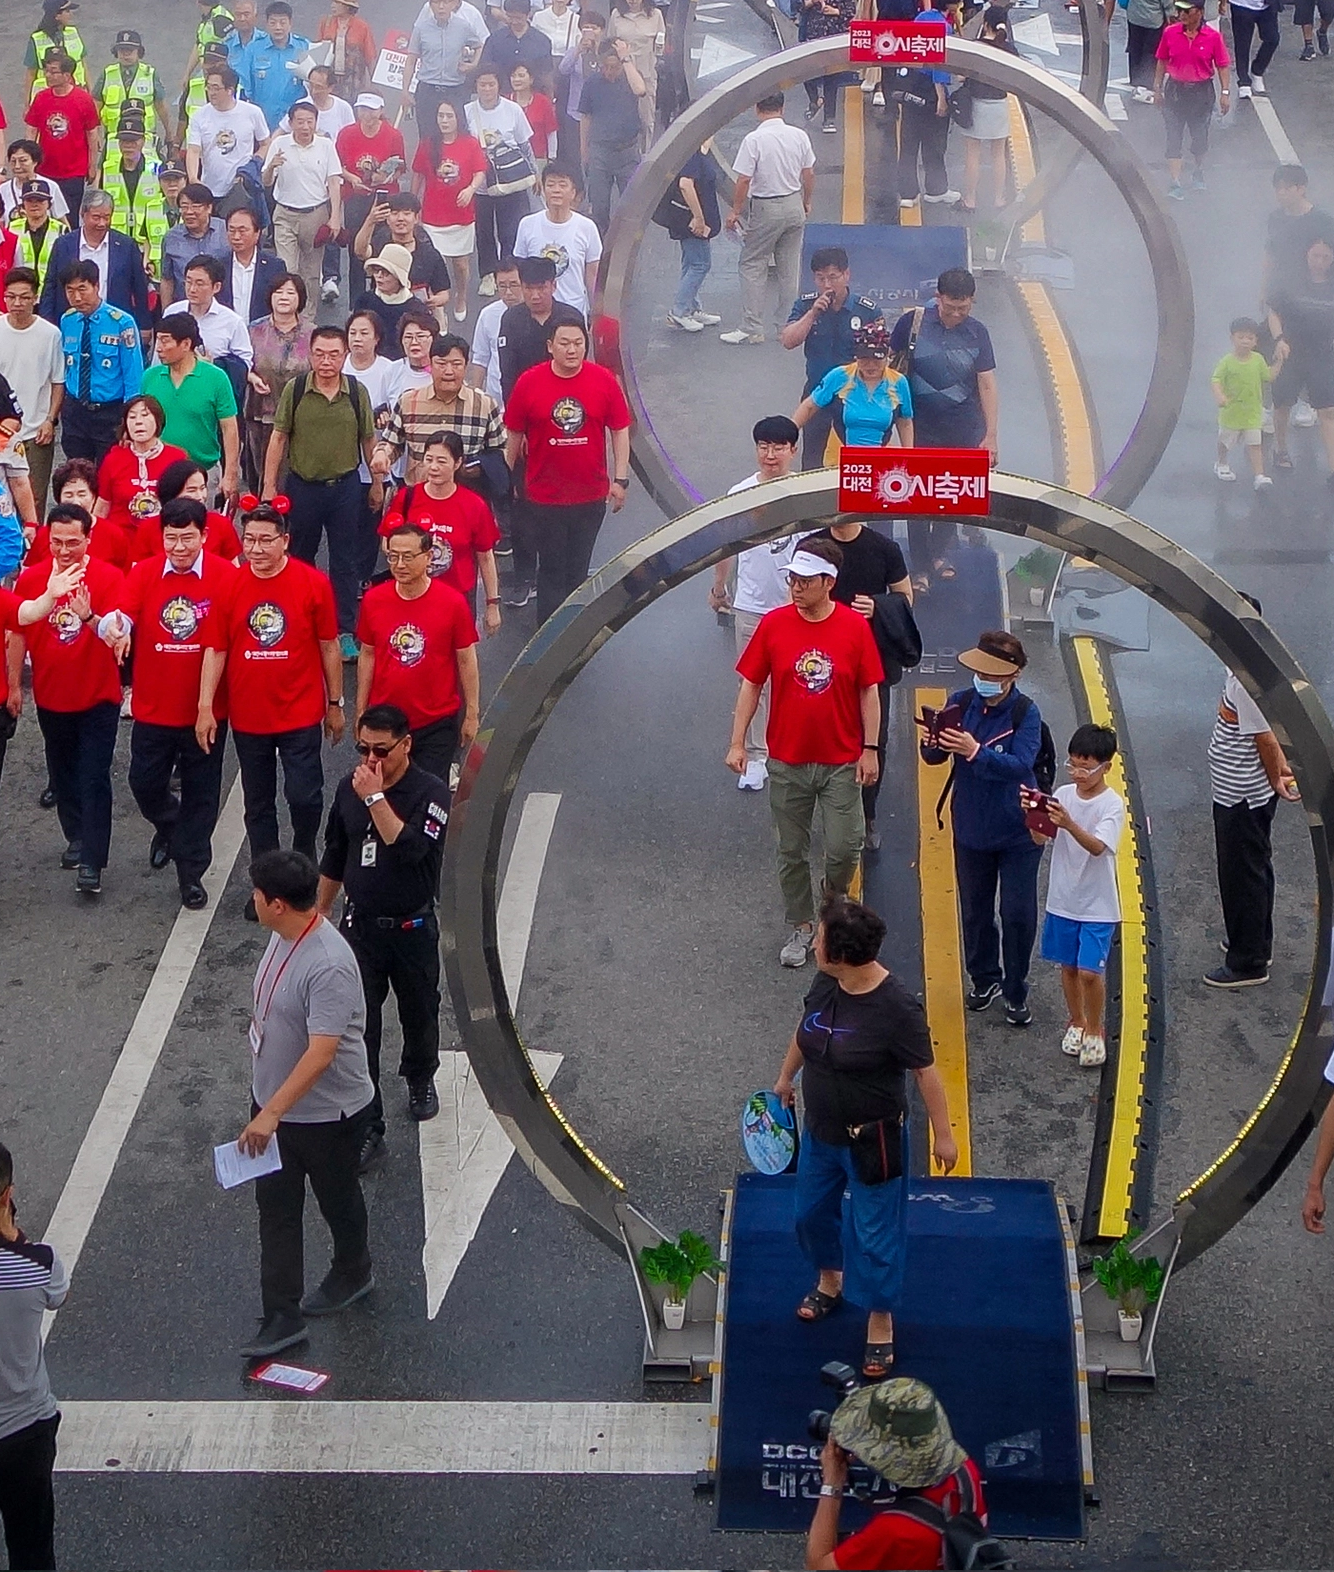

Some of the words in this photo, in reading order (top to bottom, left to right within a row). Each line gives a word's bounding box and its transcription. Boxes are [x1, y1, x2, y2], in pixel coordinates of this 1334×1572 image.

[852, 38, 871, 49] 대전
[842, 464, 873, 474] 2023
[842, 476, 873, 493] 대전
